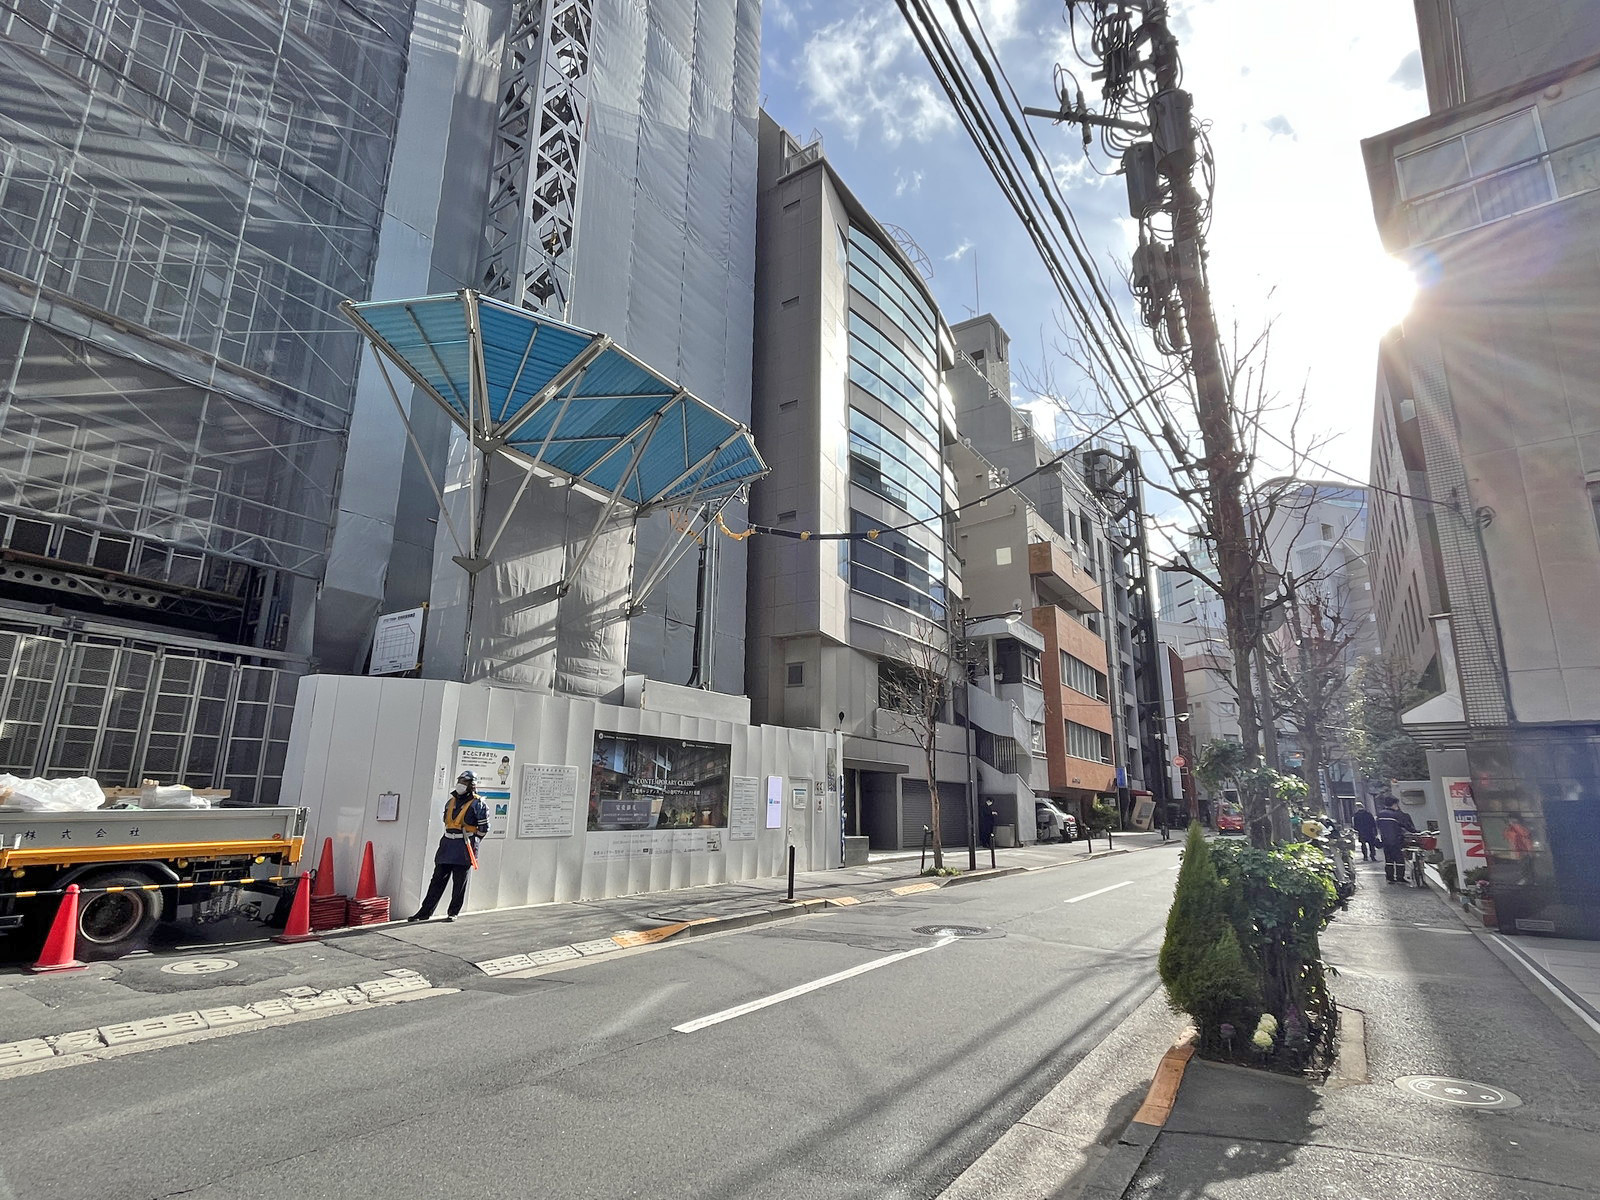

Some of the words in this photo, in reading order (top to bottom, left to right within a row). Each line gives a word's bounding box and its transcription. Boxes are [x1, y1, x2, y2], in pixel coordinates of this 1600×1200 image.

[462, 750, 498, 758] まことにすみません
[636, 778, 677, 786] CONTEMPORARY
[677, 779, 696, 787] CLASSIC
